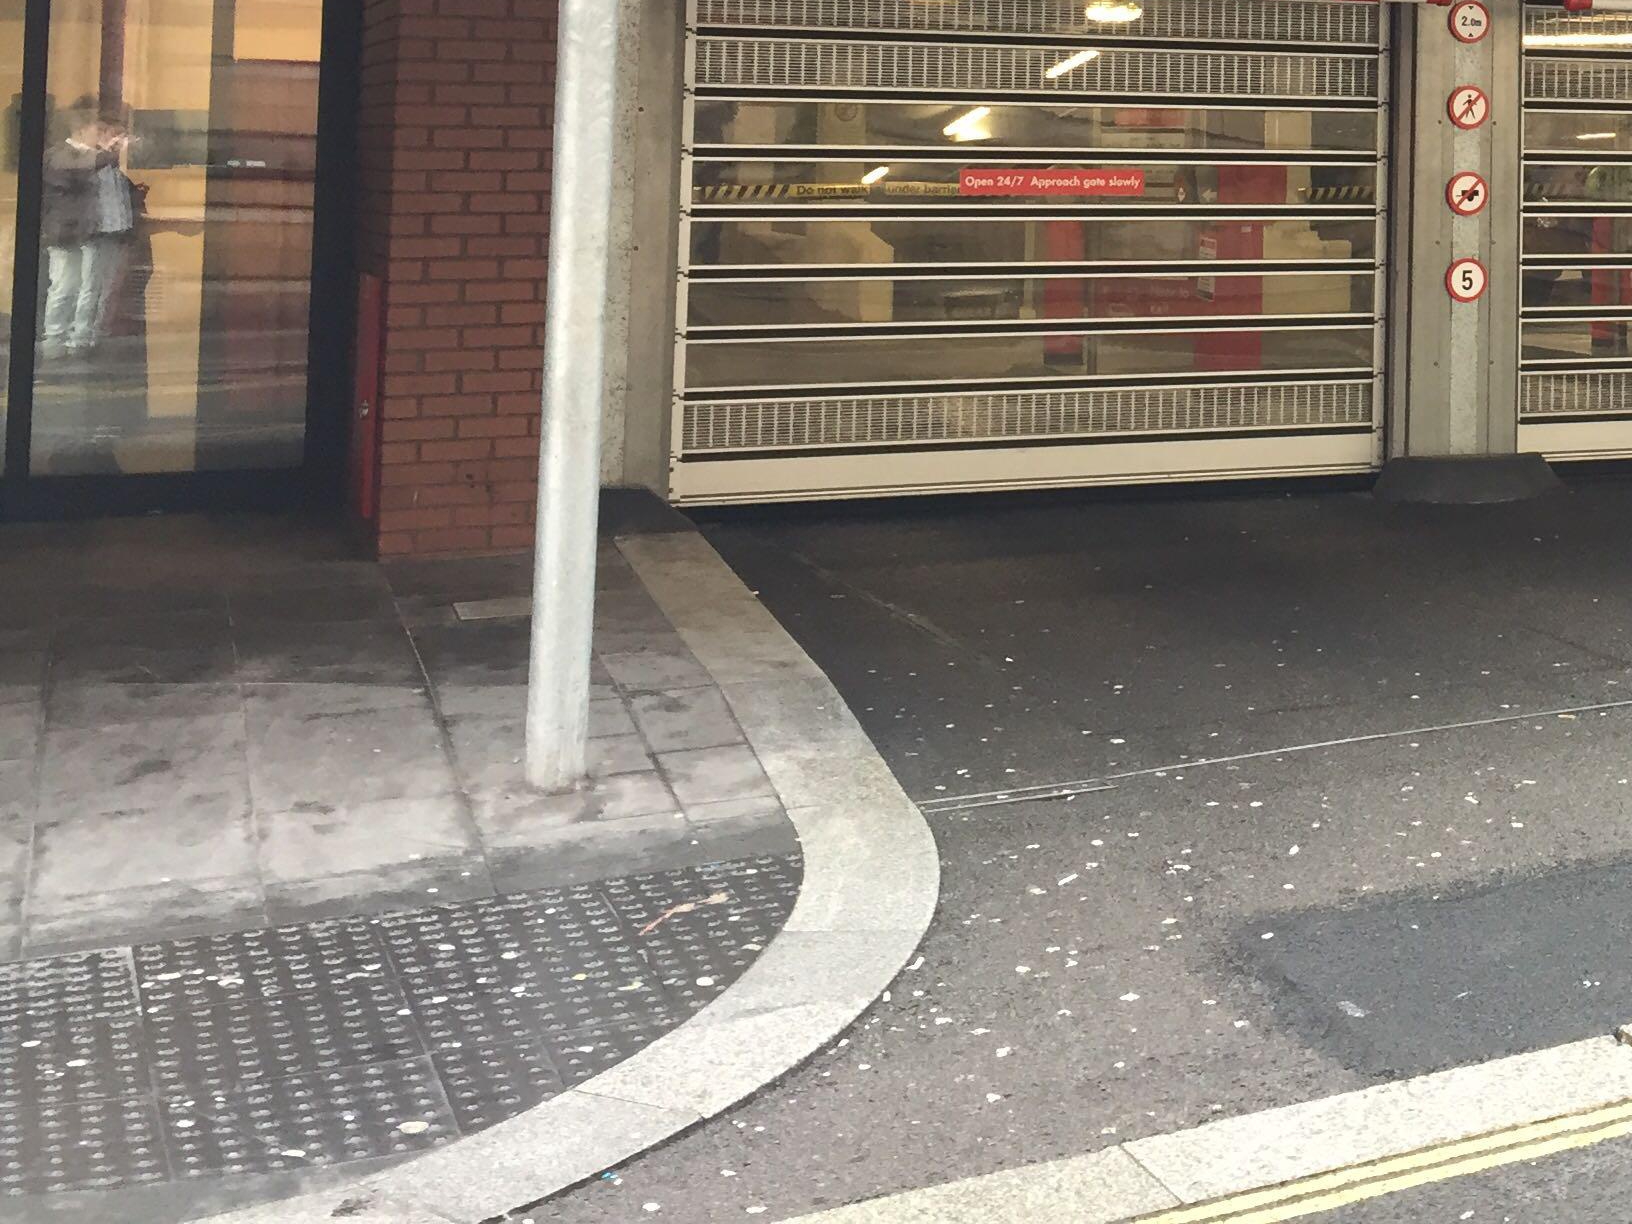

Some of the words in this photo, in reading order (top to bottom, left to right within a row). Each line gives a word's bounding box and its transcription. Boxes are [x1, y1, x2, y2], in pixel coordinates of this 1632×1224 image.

[965, 176, 993, 188] Open
[997, 176, 1024, 188] 24/7
[1030, 176, 1080, 188] Approach
[1083, 177, 1105, 189] gate
[1109, 176, 1140, 189] slowly
[1462, 269, 1473, 291] 5
